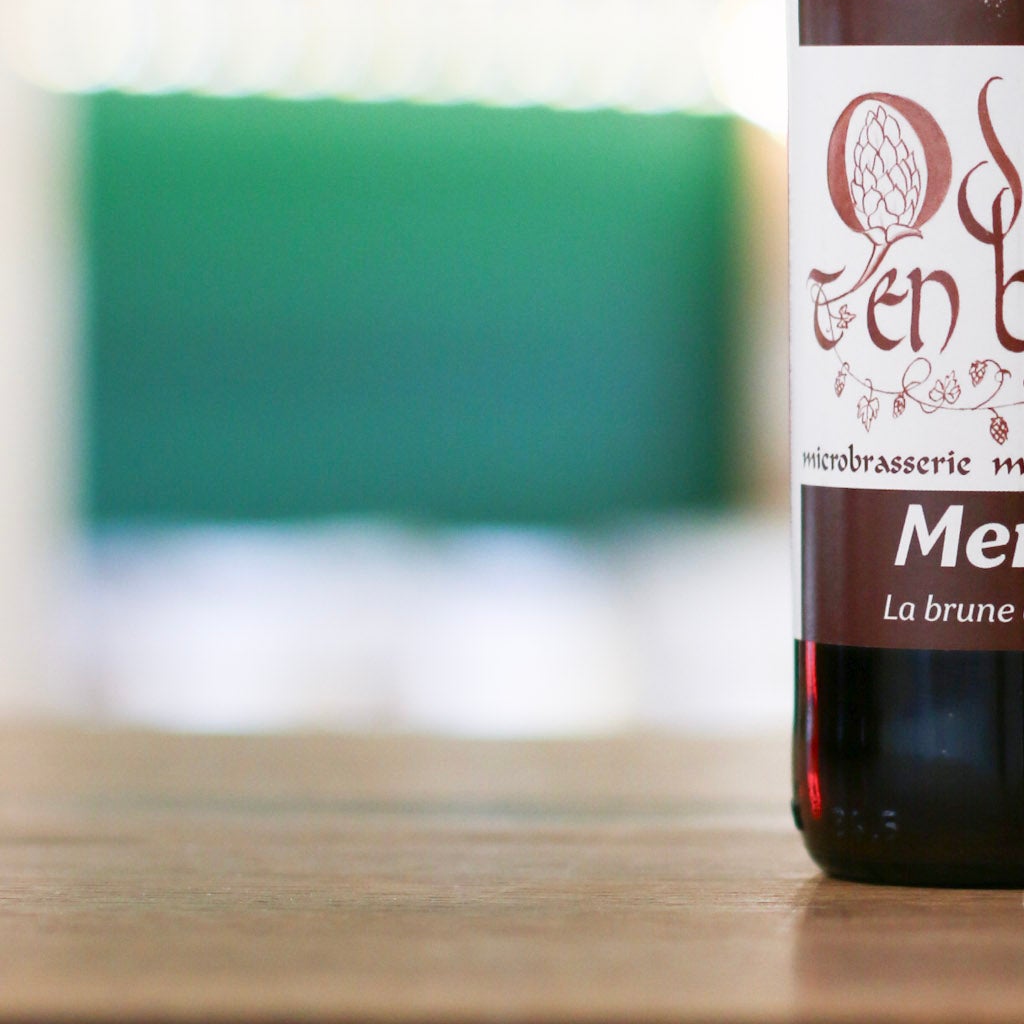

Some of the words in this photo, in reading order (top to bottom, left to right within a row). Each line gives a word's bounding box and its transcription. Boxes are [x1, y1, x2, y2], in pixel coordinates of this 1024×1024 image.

[802, 443, 971, 475] microbrasserie
[883, 593, 916, 621] La
[924, 594, 1015, 623] brune
